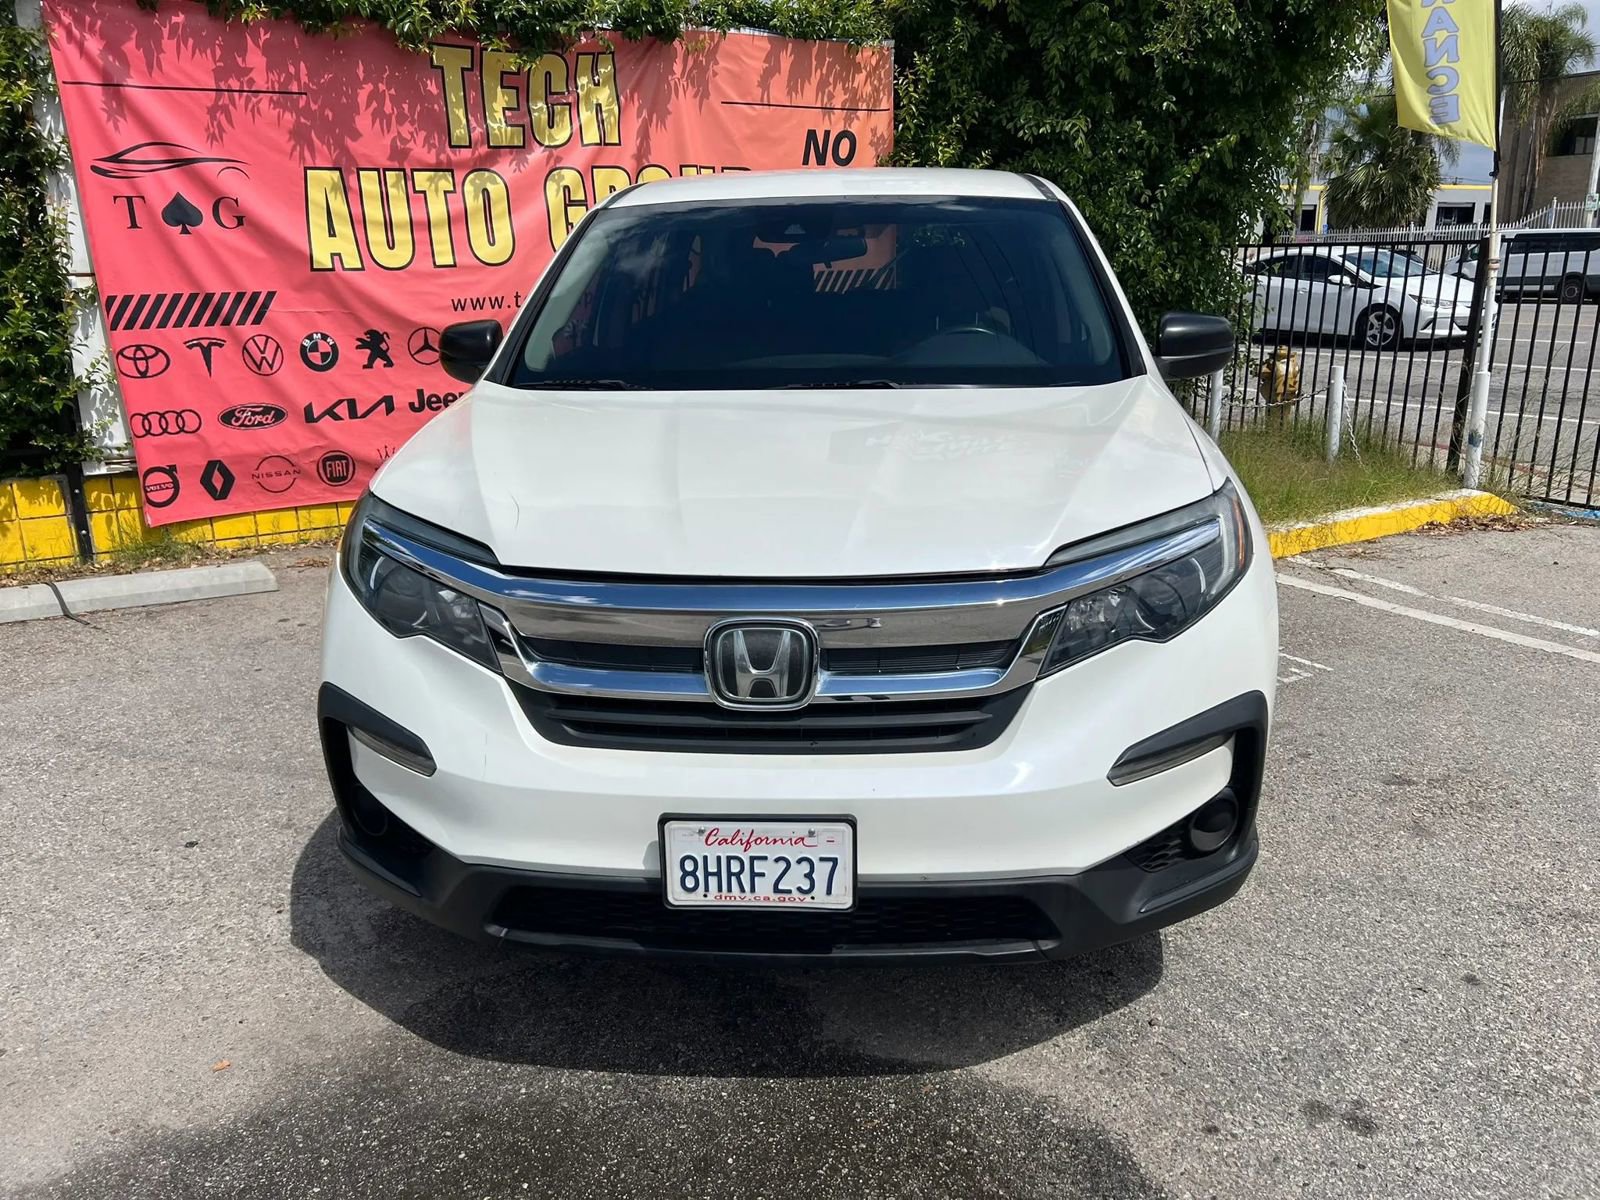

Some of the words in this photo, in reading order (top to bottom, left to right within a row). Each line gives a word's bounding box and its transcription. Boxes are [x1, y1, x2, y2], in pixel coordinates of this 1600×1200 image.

[430, 43, 622, 148] TECH
[802, 129, 857, 167] NO
[304, 167, 516, 272] AUTO
[451, 291, 528, 312] www.t
[302, 332, 335, 347] BMW
[408, 388, 465, 413] Jee
[231, 406, 276, 426] Ford
[251, 468, 302, 480] NISSAN
[325, 459, 348, 478] FIAT
[145, 481, 174, 492] VOLVO
[704, 827, 818, 852] California
[679, 854, 839, 896] 8HRF237
[713, 892, 806, 903] dmv.ca.gov
